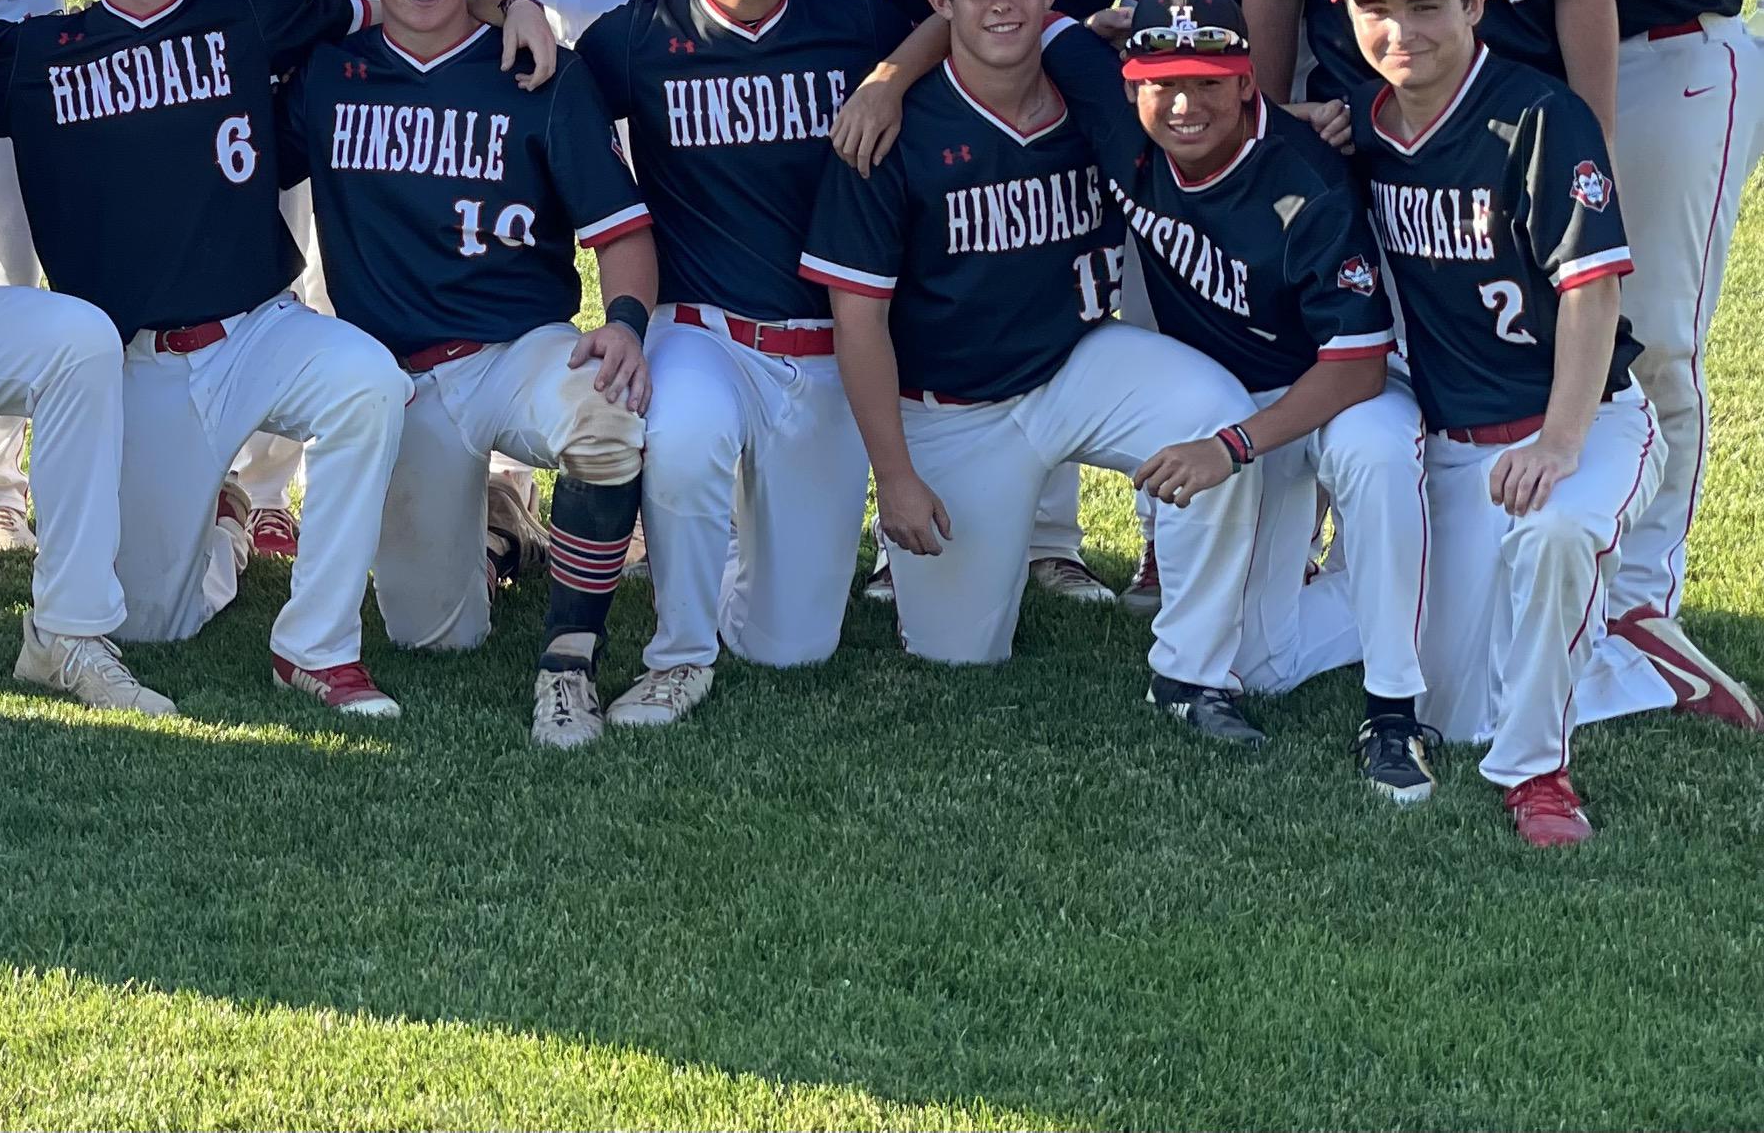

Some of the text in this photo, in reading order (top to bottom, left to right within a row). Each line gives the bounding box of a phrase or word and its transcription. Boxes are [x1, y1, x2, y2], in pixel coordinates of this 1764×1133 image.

[49, 31, 232, 125] HINSDALE
[664, 70, 845, 147] HINSDALE
[216, 113, 257, 183] 6
[331, 102, 511, 181] HINSDALE
[947, 165, 1103, 254] HINSDALE
[1479, 280, 1537, 345] 2
